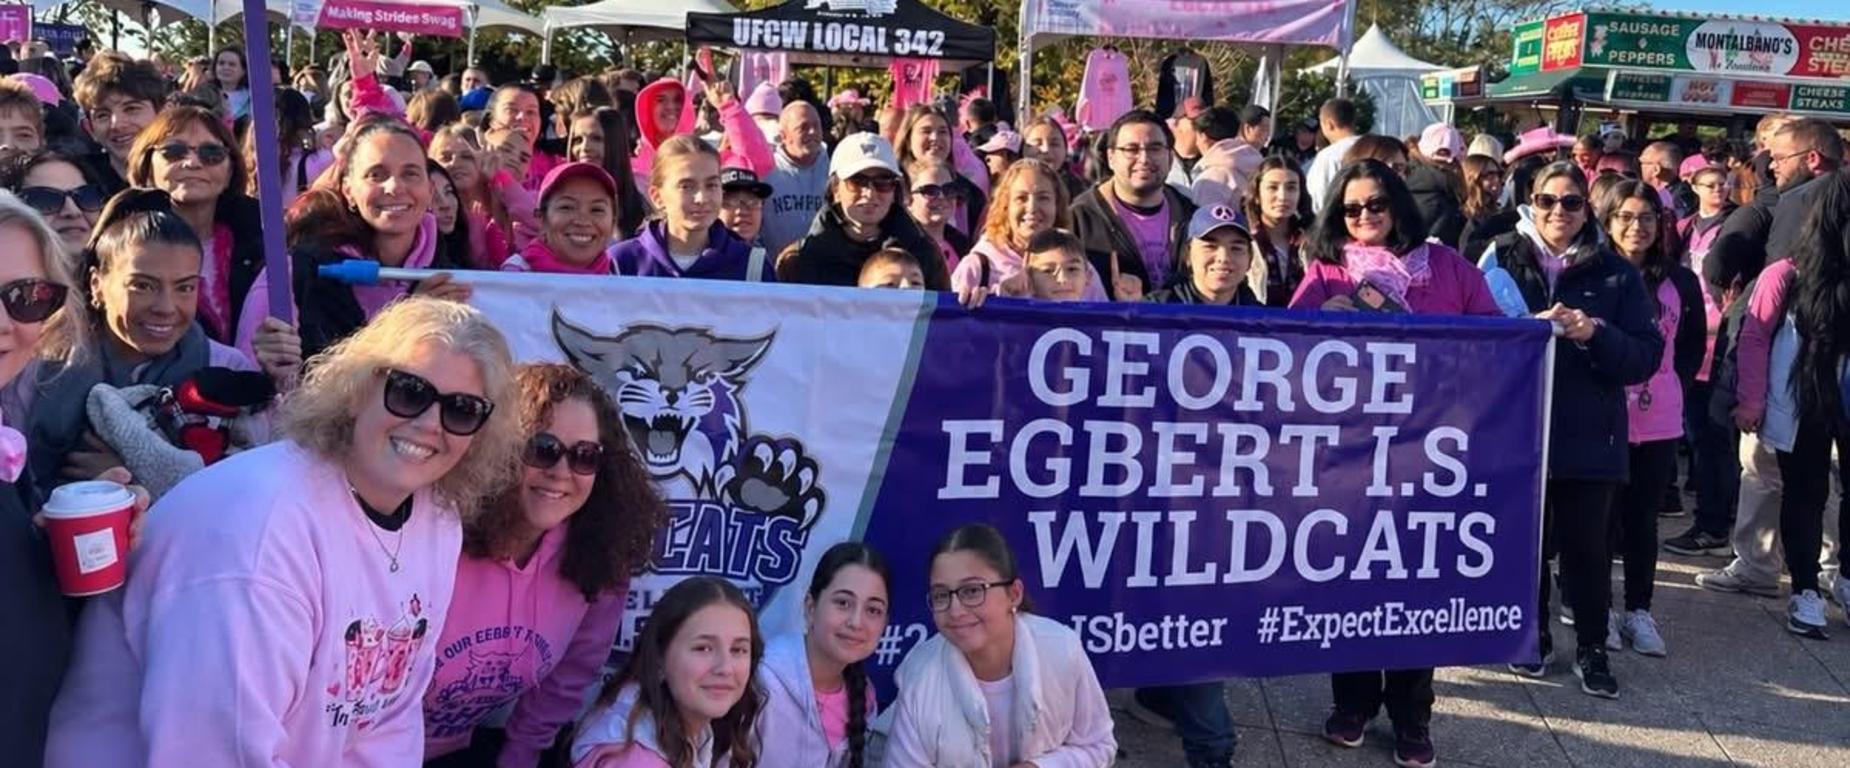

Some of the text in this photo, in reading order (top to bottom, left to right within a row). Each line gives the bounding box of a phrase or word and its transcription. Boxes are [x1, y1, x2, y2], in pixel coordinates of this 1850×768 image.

[328, 7, 373, 23] Making
[374, 9, 420, 25] Strides
[421, 13, 456, 29] Swag
[1609, 22, 1680, 36] SAUSAGE
[733, 18, 945, 56] UFCW LOCAL 342
[1695, 32, 1793, 54] MONTALBANO'S
[1608, 50, 1676, 65] PEPPERS
[1798, 87, 1846, 98] CHEESE
[1798, 98, 1844, 109] STEAKS
[1028, 328, 1416, 415] GEORGE
[937, 418, 1488, 500] EGBERT I.S.
[650, 500, 808, 584] CATS
[1027, 509, 1496, 589] WILDCATS
[1257, 598, 1522, 649] #ExpectExcellence
[444, 636, 472, 659] OUR
